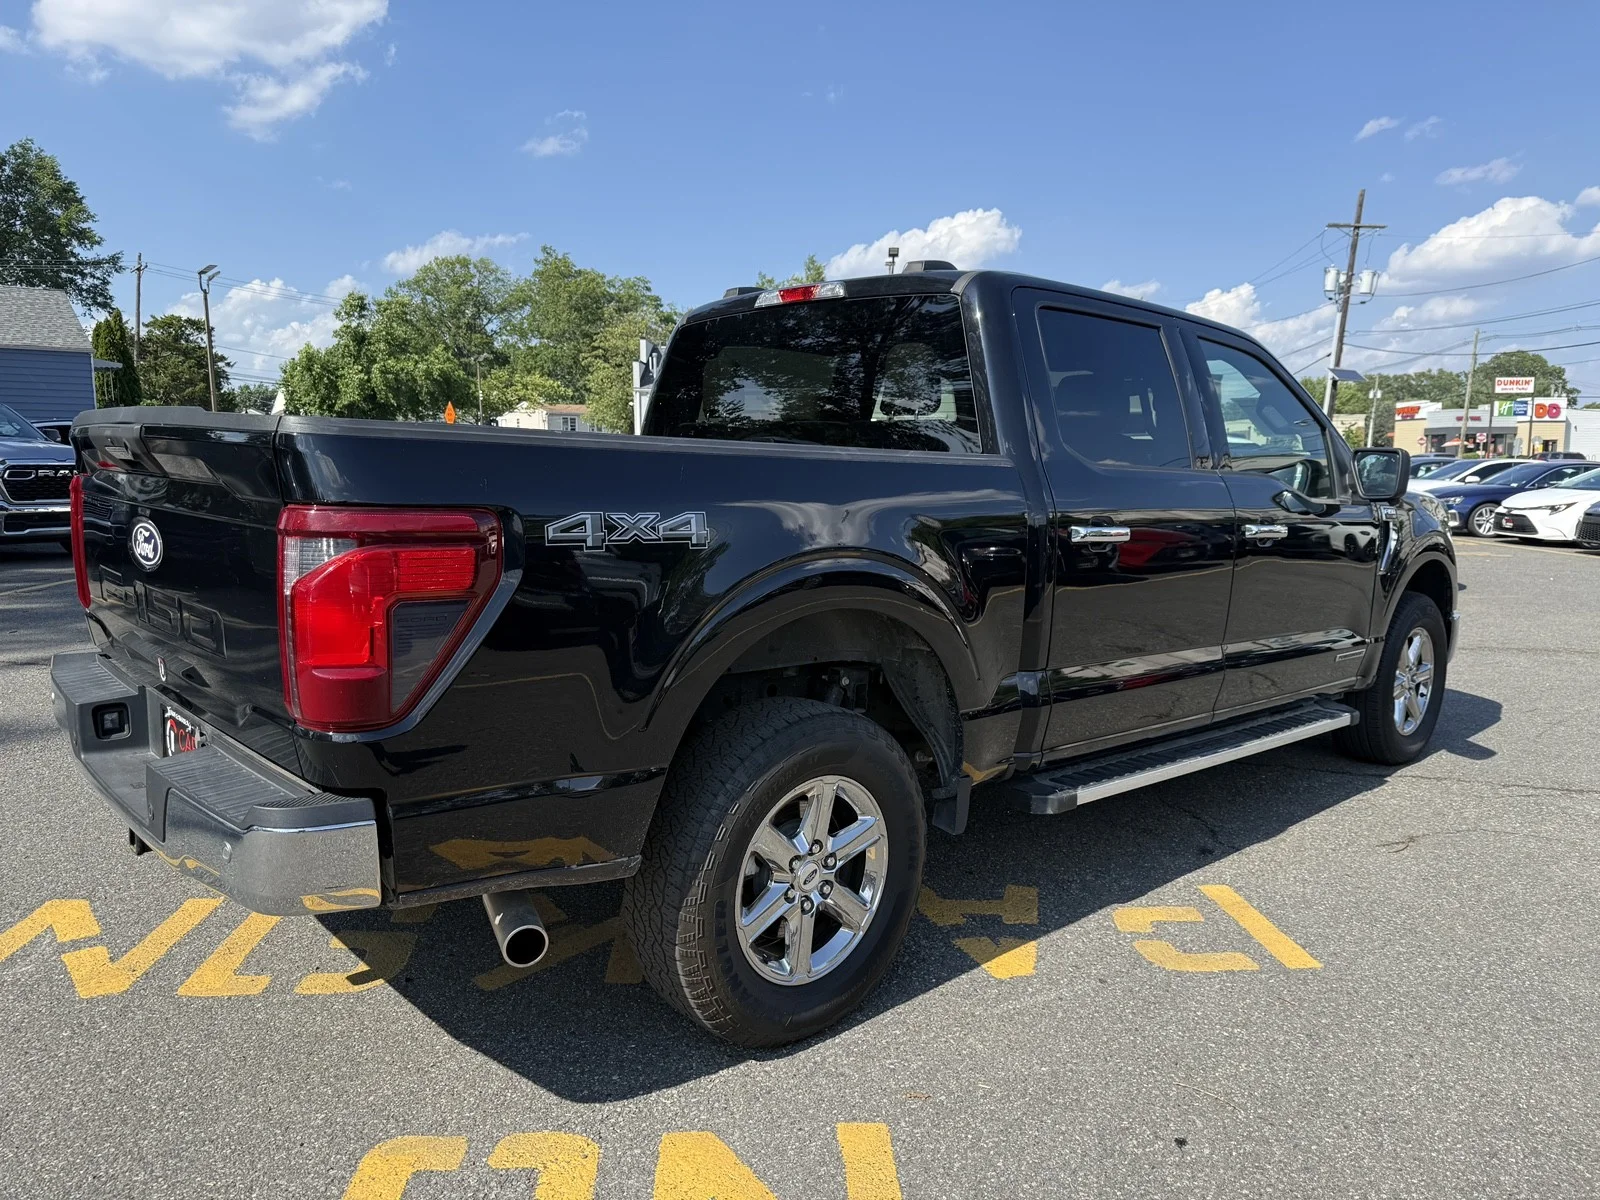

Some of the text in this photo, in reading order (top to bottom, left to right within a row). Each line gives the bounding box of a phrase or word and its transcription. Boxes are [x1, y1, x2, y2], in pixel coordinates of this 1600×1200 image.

[1534, 403, 1561, 419] DD
[37, 469, 79, 477] RA
[136, 527, 155, 559] Ford
